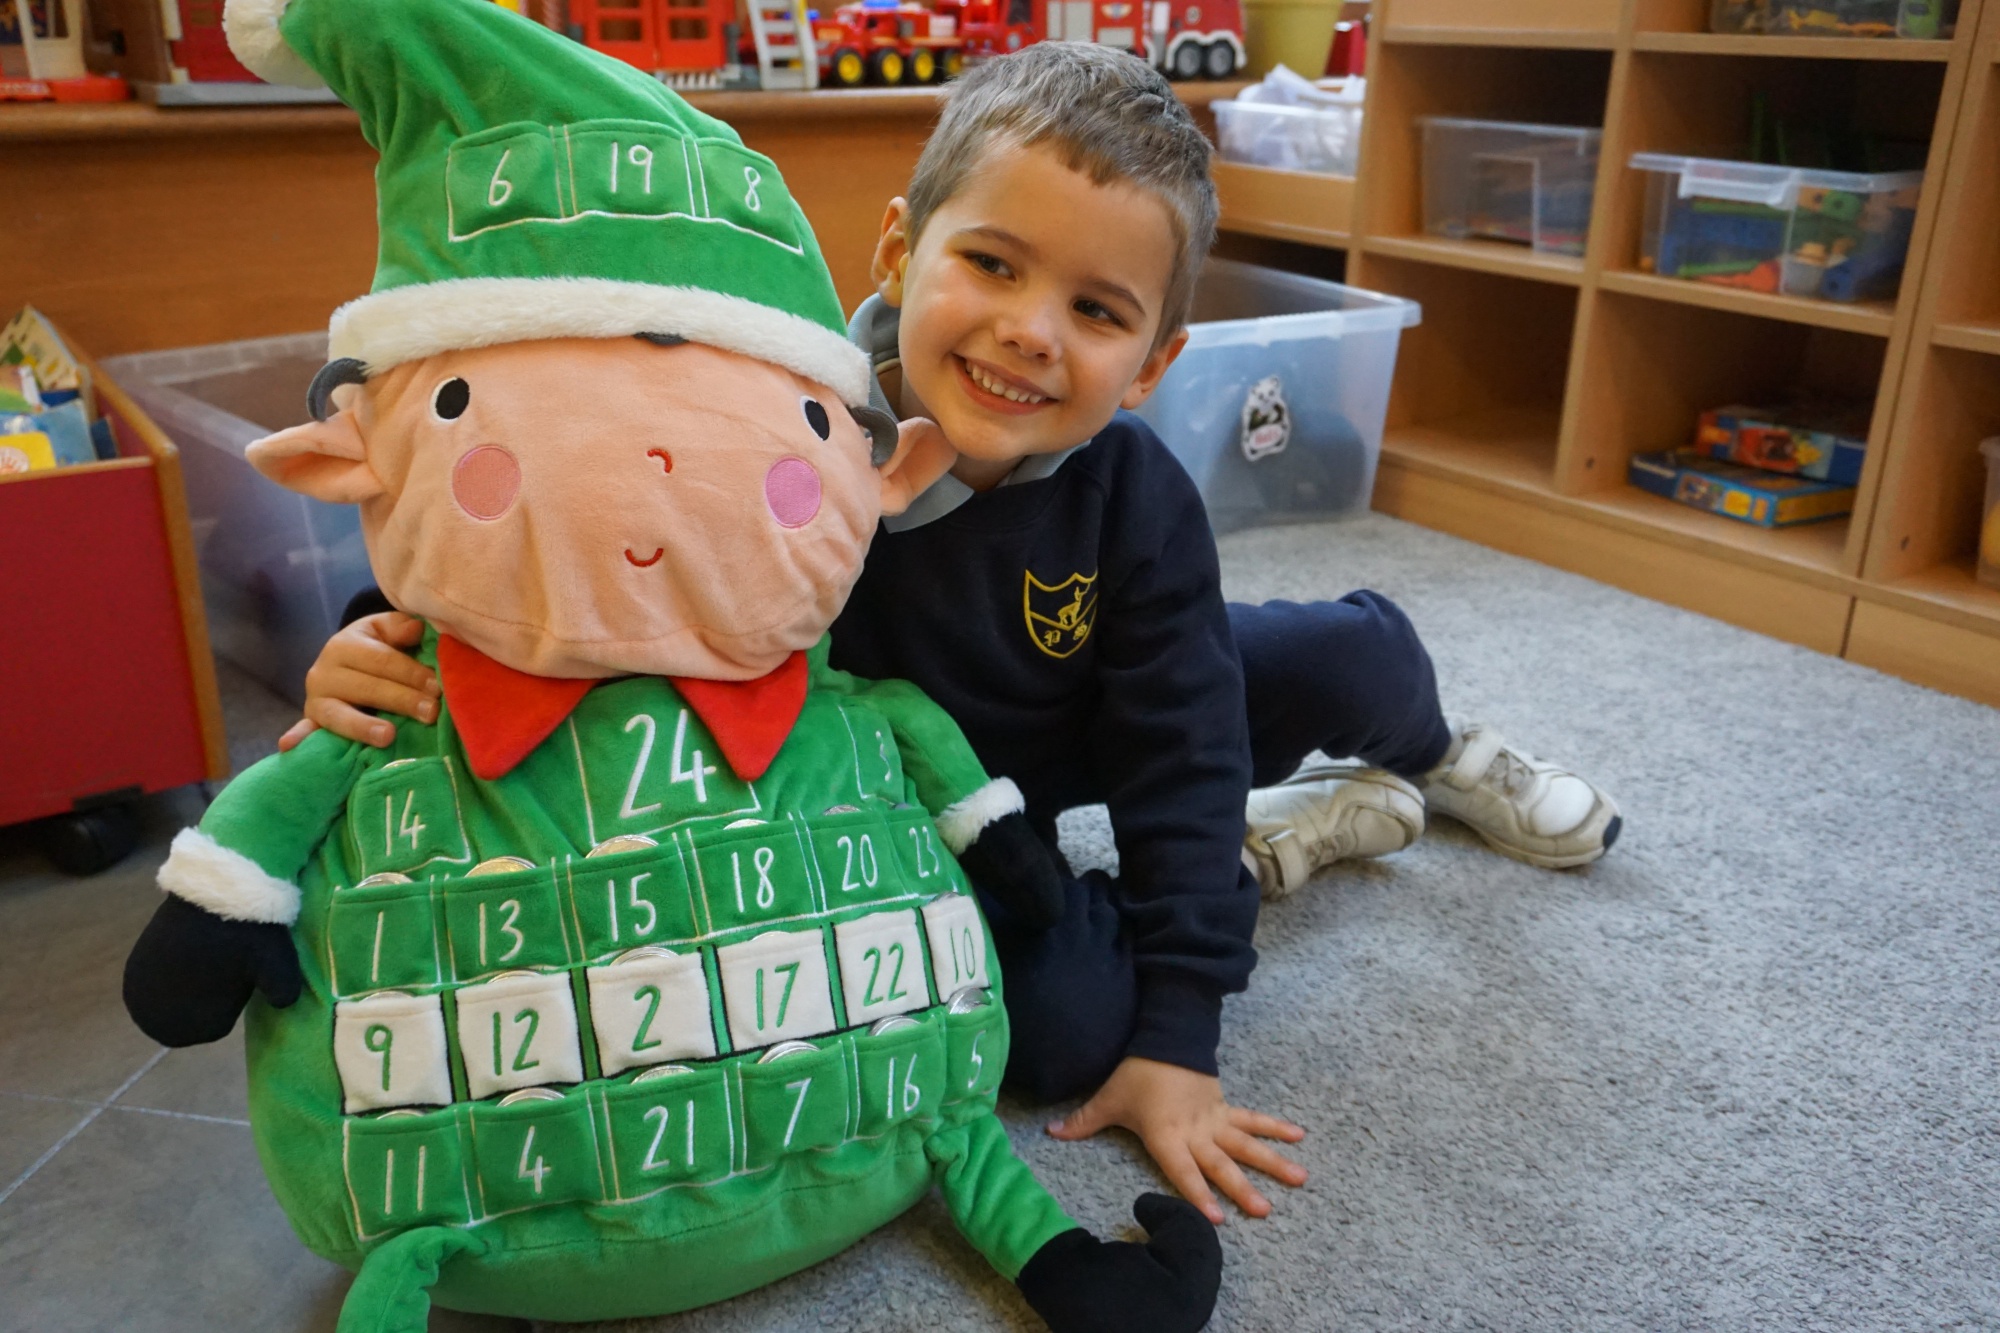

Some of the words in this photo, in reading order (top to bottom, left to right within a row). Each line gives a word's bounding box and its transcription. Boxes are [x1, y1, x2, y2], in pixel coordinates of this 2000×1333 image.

[488, 149, 513, 206] 6
[611, 142, 653, 194] 19
[744, 166, 761, 212] 8
[619, 708, 716, 818] 24
[386, 790, 426, 857] 14
[731, 847, 774, 913] 18
[837, 834, 878, 891] 20
[479, 899, 524, 966] 13
[608, 872, 657, 942] 15
[372, 911, 384, 982] 1
[863, 943, 907, 1007] 22
[949, 926, 977, 984] 10
[632, 985, 662, 1051] 2
[756, 961, 800, 1031] 17
[364, 1024, 393, 1091] 9
[493, 1008, 540, 1076] 12
[967, 1030, 987, 1090] 5
[783, 1077, 813, 1148] 7
[886, 1053, 921, 1119] 16
[518, 1125, 551, 1195] 4
[642, 1100, 694, 1171] 21
[384, 1145, 427, 1216] 11
